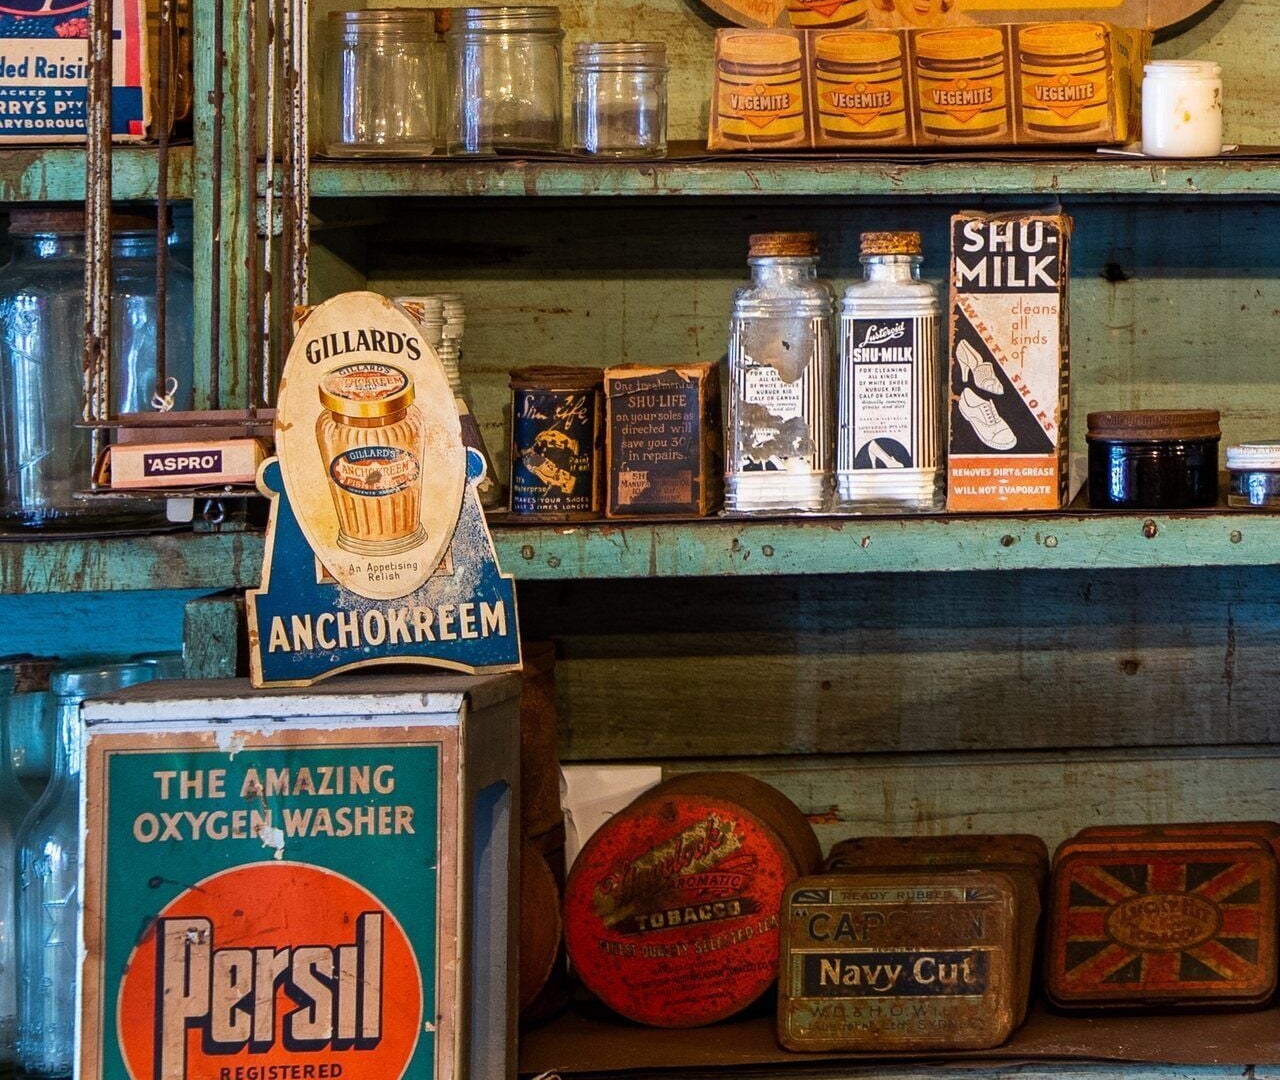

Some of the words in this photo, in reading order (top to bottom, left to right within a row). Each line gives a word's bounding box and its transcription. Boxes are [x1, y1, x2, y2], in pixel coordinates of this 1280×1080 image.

[830, 90, 892, 108] VEGEMITE
[932, 86, 994, 106] VEGEMITE
[1034, 82, 1094, 102] VEGEMITE
[962, 221, 1057, 253] SHU-
[955, 255, 1057, 288] MILK
[1011, 303, 1057, 315] cleans
[1011, 318, 1028, 330] all
[859, 321, 905, 348] Lusteroid
[1011, 332, 1048, 345] kinds
[305, 329, 422, 365] GILLARD'S
[1010, 346, 1027, 366] of
[630, 412, 658, 424] your
[658, 411, 681, 420] soles
[621, 424, 665, 435] directed
[670, 423, 692, 433] will
[350, 450, 396, 460] GILLARD'S
[952, 468, 992, 477] REMOVES
[953, 486, 976, 495] WILL
[978, 486, 997, 495] NOT
[999, 485, 1051, 495] EVAPORATE
[366, 560, 418, 575] Appetising
[368, 571, 400, 582] Relish
[268, 600, 508, 653] ANCHOKREEM
[153, 769, 226, 801] THE
[239, 765, 395, 799] AMAZING
[132, 808, 274, 844] OXYGEN
[283, 805, 416, 838] WASHER
[665, 873, 741, 890] AROMATIC
[635, 901, 741, 932] TOBACCO
[819, 958, 902, 992] Navy
[913, 958, 974, 985] Cut
[153, 910, 384, 1080] Persil
[220, 1062, 343, 1080] REGISTERED
